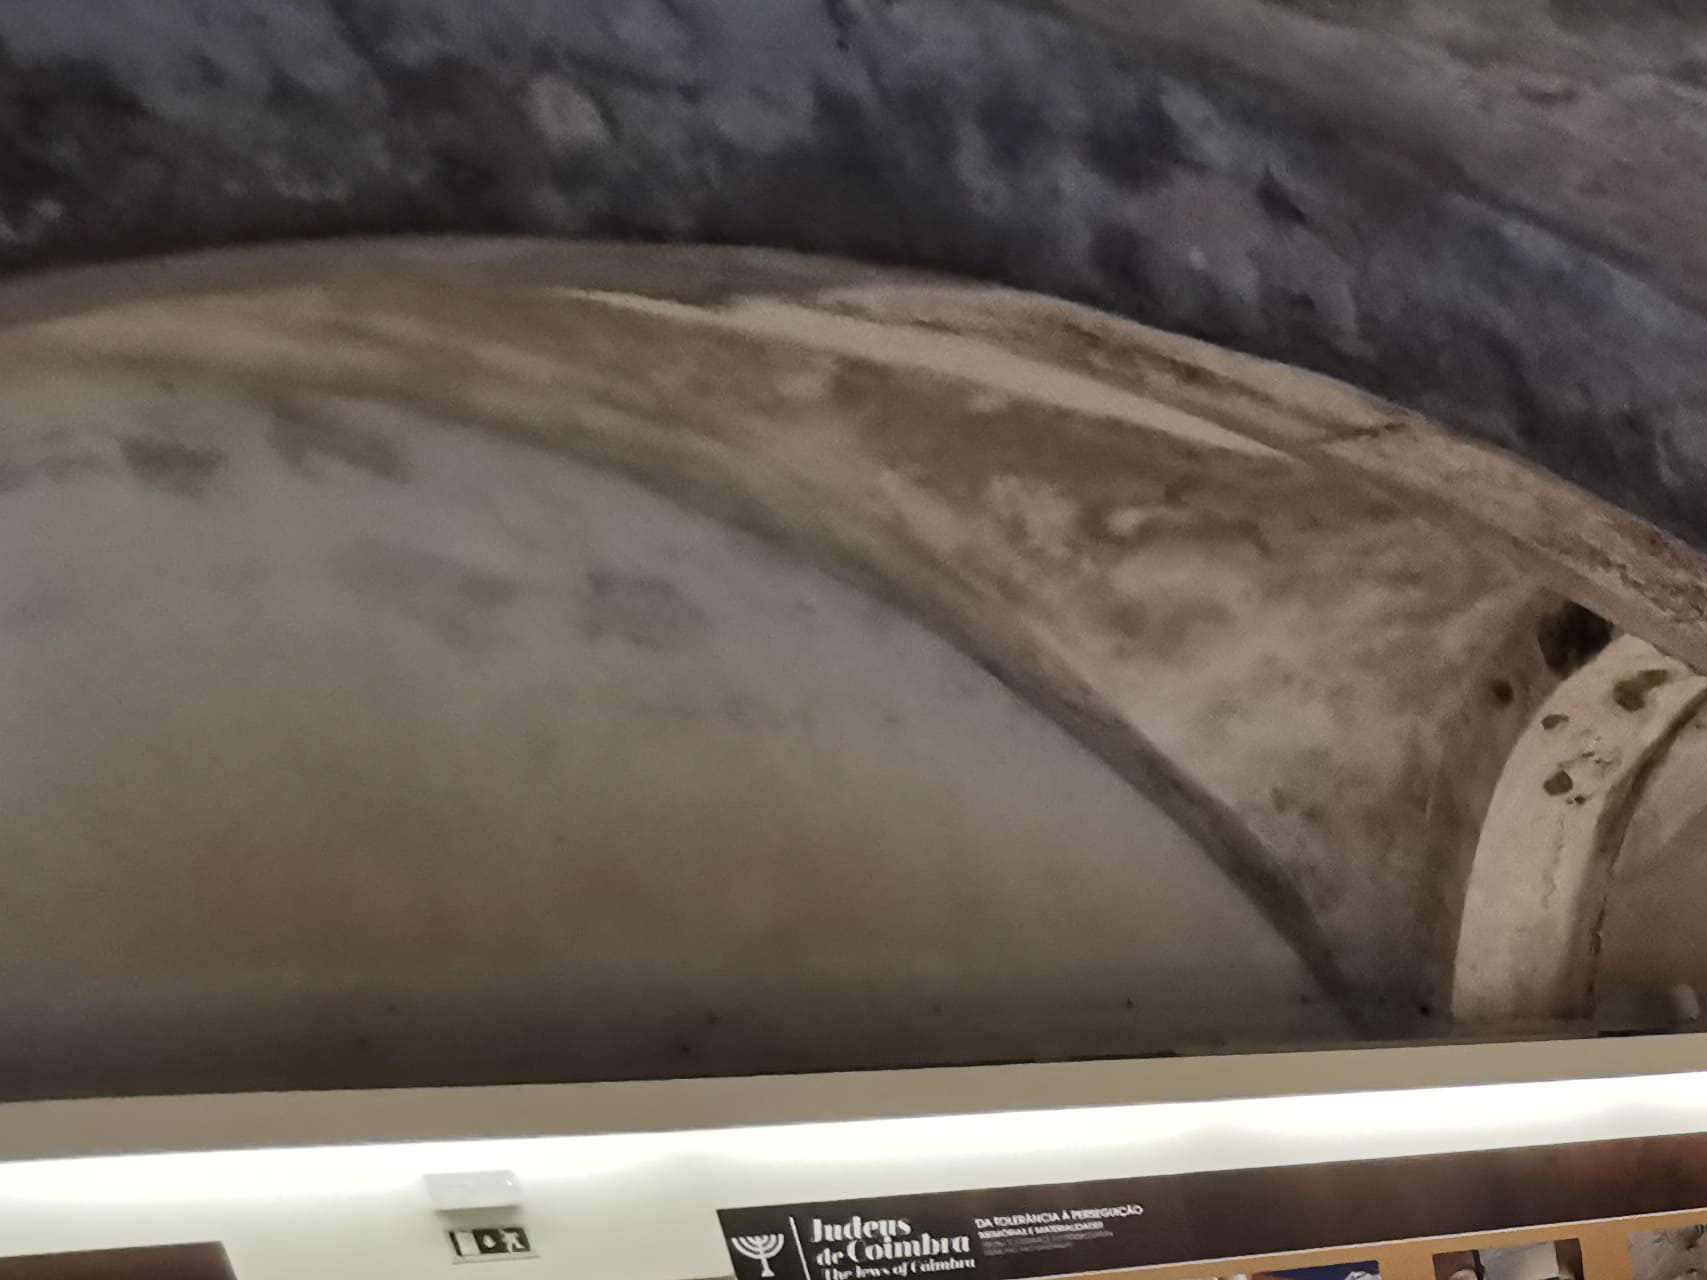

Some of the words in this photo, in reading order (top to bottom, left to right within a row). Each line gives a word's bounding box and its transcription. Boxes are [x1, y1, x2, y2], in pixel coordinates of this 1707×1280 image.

[811, 1216, 911, 1243] Judeus
[975, 1217, 993, 1229] DA
[1070, 1204, 1144, 1220] PERSEGUIÇÃO
[816, 1248, 844, 1266] de
[847, 1232, 970, 1262] Coimbra
[854, 1264, 890, 1278] Jews
[892, 1260, 909, 1277] of
[910, 1257, 976, 1273] Coimbra
